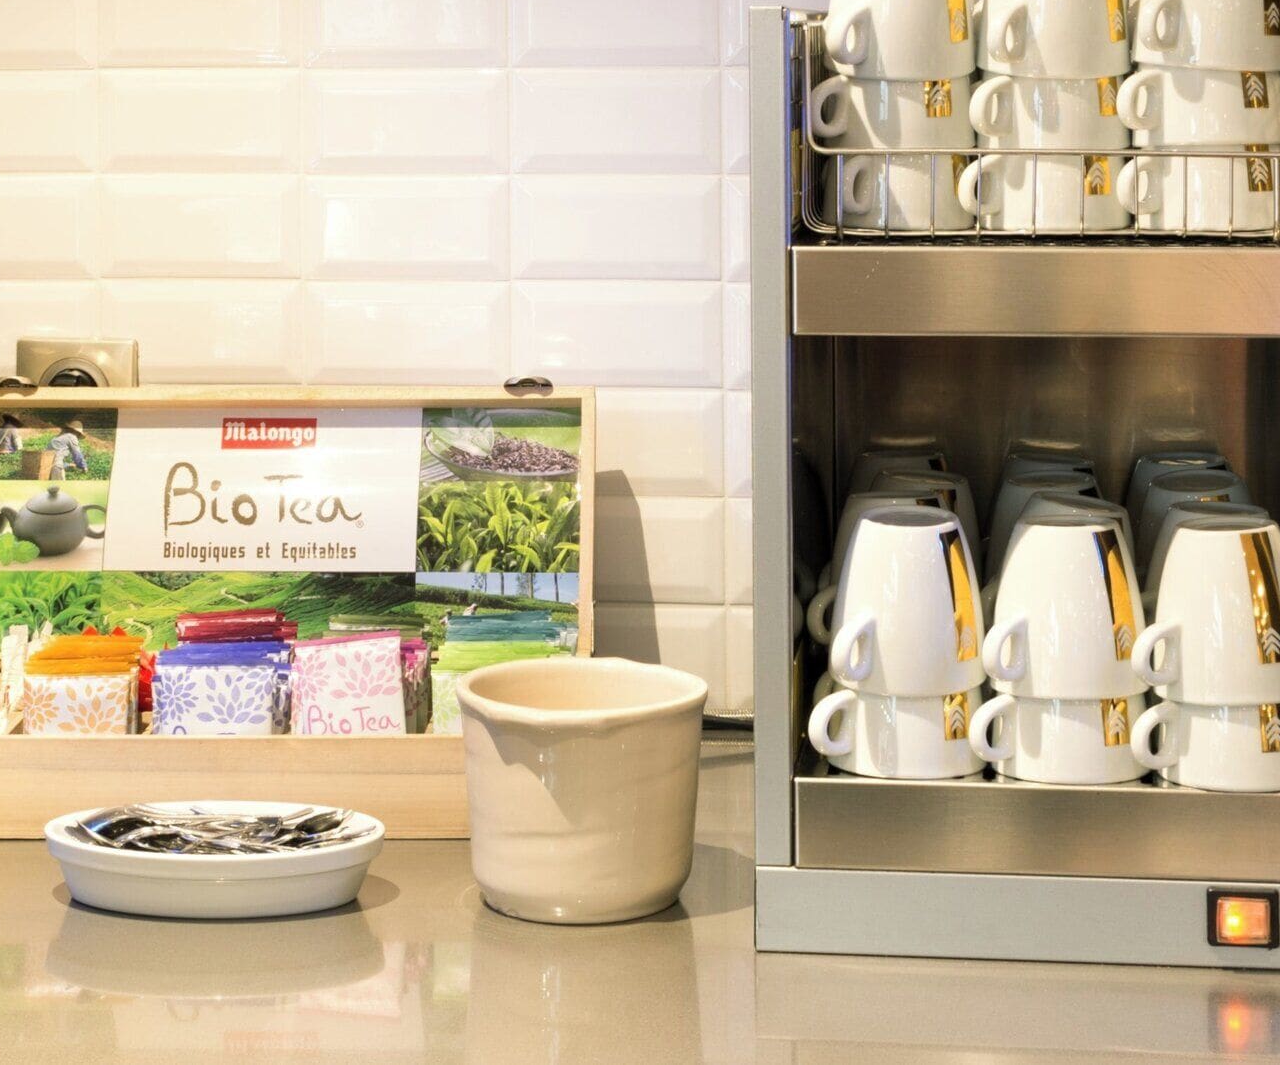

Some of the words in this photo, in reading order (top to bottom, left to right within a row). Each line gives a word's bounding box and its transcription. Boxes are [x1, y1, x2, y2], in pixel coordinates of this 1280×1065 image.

[224, 421, 315, 446] Malongo
[163, 541, 246, 563] Biologiques
[256, 542, 270, 559] et
[281, 542, 357, 563] Equitables
